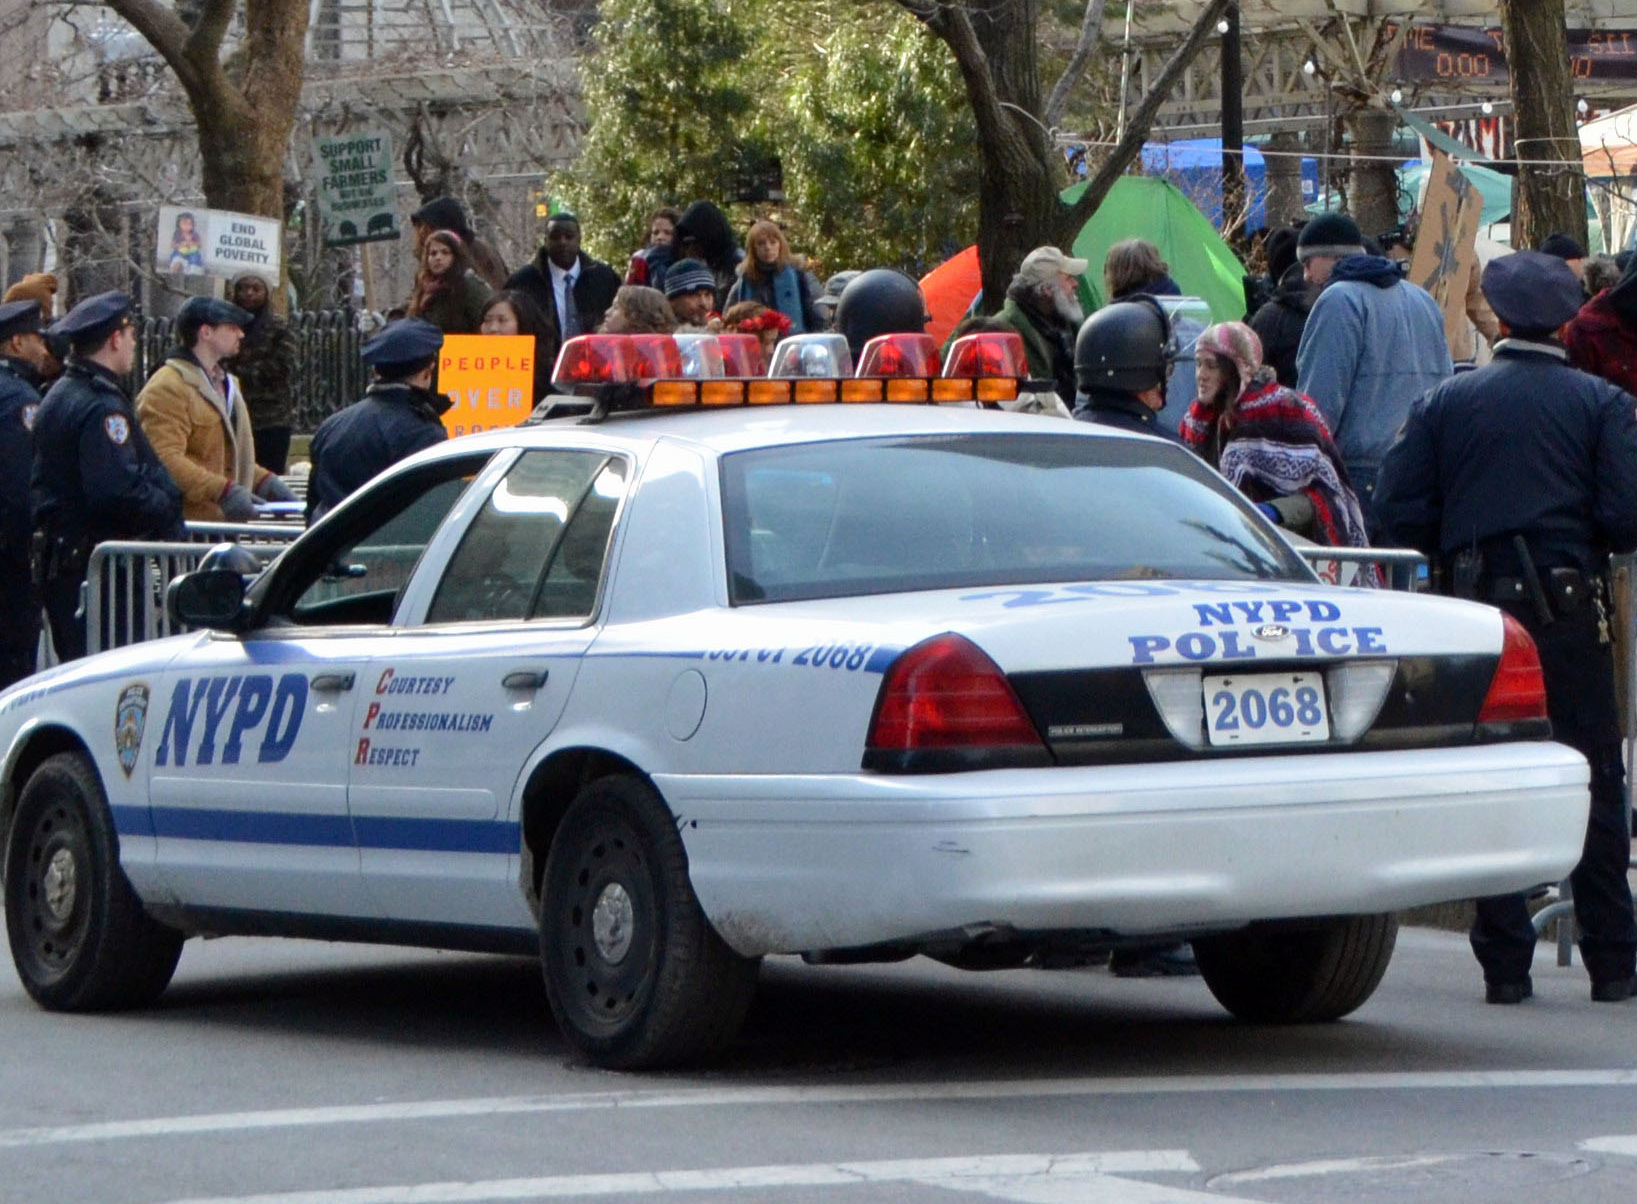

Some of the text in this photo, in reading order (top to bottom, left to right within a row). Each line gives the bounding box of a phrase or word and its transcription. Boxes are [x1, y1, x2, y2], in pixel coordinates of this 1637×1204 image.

[1437, 53, 1489, 77] 0.00
[320, 138, 382, 159] SUPPORT
[330, 155, 376, 172] SMALL
[322, 173, 388, 190] FARMERS
[231, 222, 256, 236] END
[219, 234, 266, 251] GLOBAL
[215, 248, 269, 265] POVERTY
[442, 357, 532, 372] PEOPLE
[1192, 600, 1342, 626] NYPD
[792, 640, 873, 671] 2068
[376, 668, 455, 695] COURTESY
[155, 673, 308, 767] NYPD
[363, 702, 495, 732] PROFESSIONALISM
[1212, 686, 1322, 731] 2068
[354, 737, 421, 766] RESPECT
